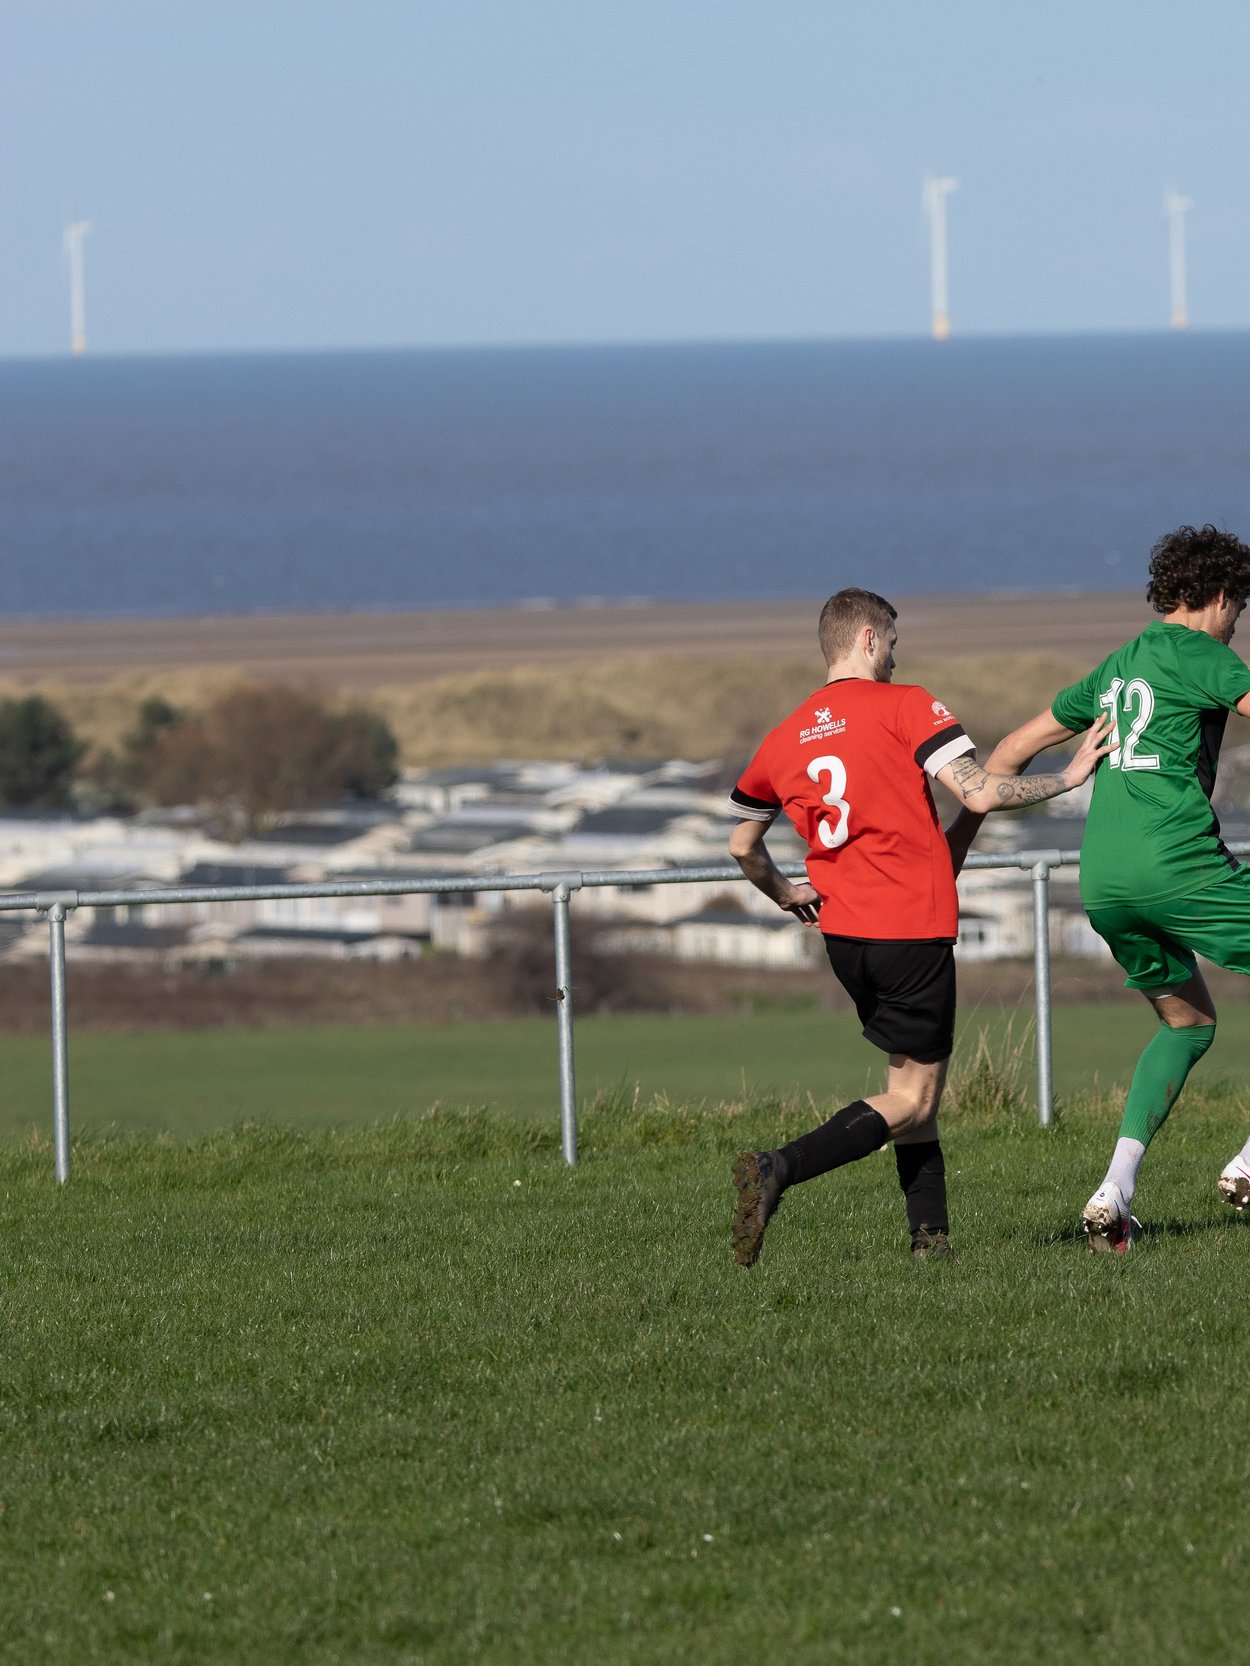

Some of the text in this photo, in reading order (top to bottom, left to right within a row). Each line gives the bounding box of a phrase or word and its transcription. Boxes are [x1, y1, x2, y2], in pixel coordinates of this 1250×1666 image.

[800, 718, 846, 739] RG HOWELLS
[800, 727, 846, 744] cleaning services
[1099, 677, 1160, 771] 12
[806, 755, 850, 848] 3
